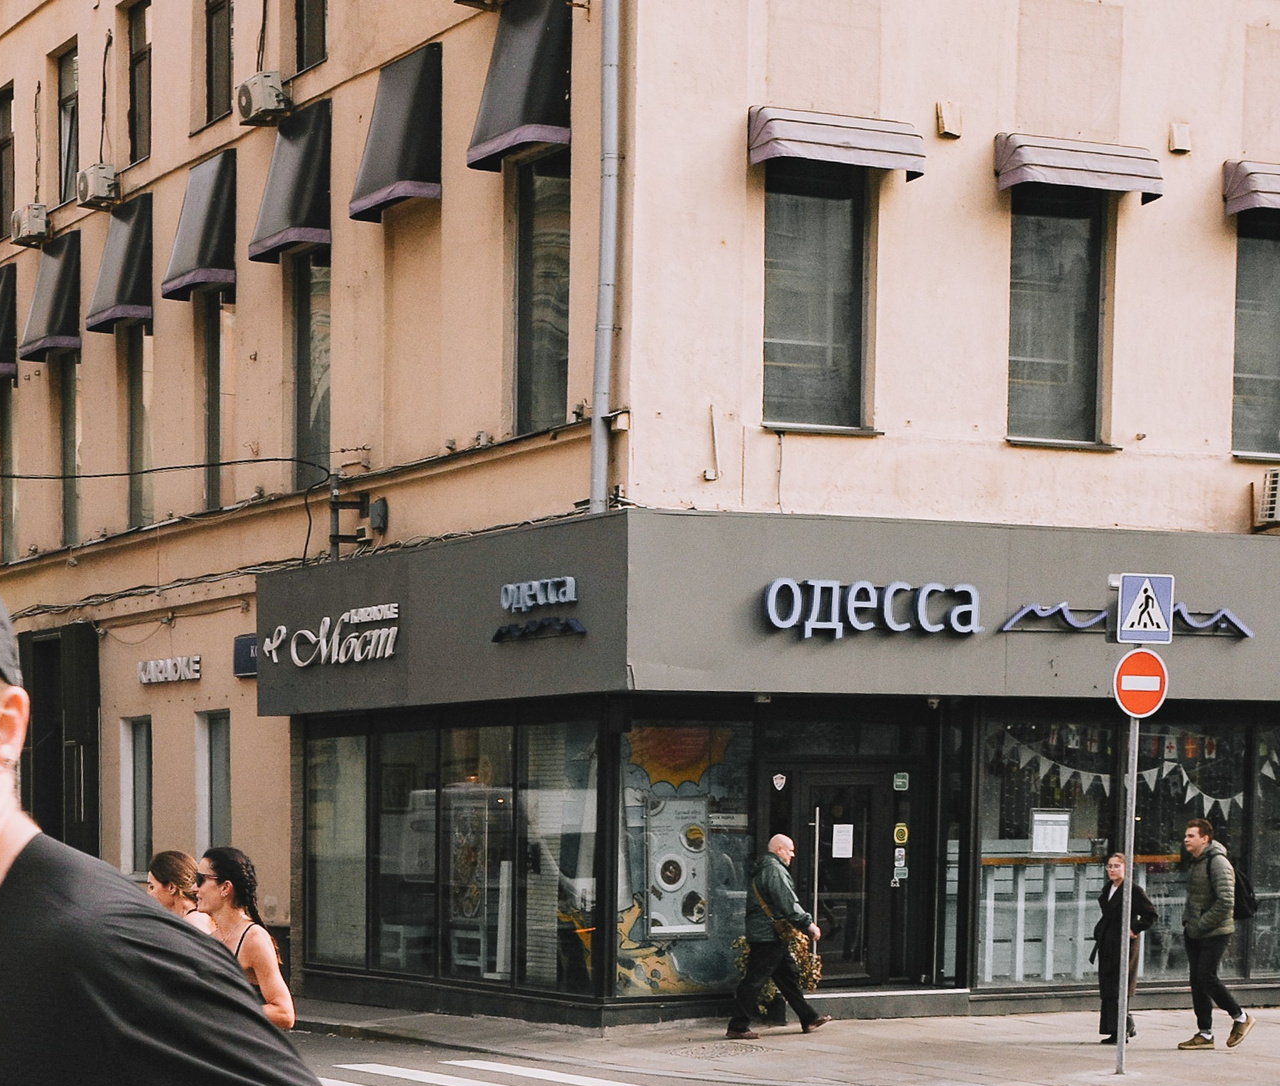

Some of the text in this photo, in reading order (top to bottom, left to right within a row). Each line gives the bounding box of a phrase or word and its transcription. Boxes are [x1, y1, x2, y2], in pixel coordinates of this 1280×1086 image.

[350, 603, 399, 624] KARAOKE
[500, 576, 578, 614] одесса
[766, 577, 985, 639] одесса
[290, 612, 398, 668] Мост
[138, 655, 201, 684] KARAOKE
